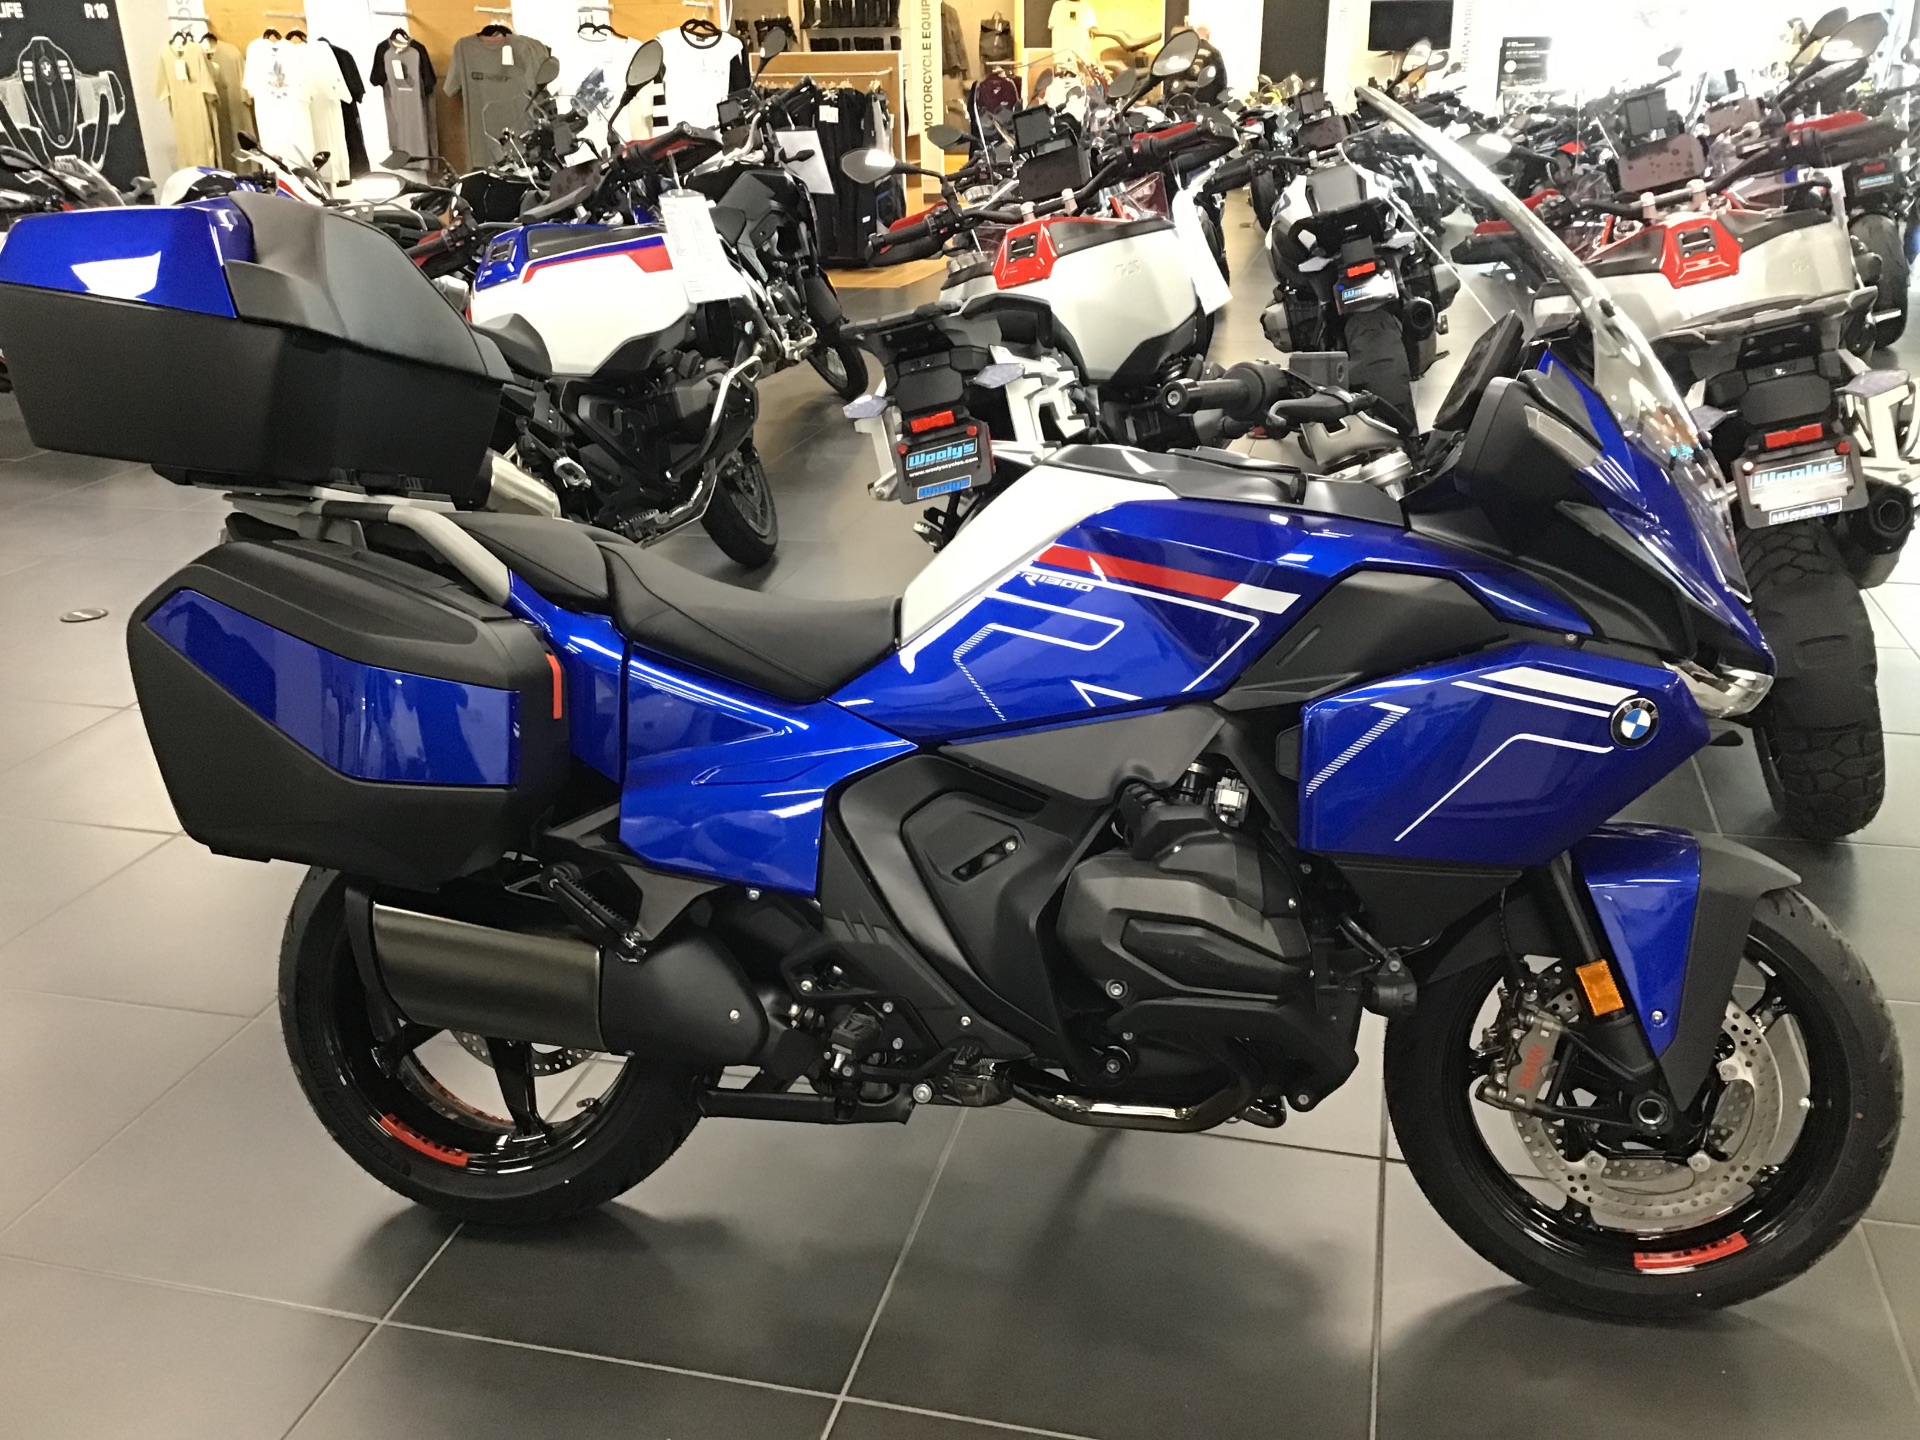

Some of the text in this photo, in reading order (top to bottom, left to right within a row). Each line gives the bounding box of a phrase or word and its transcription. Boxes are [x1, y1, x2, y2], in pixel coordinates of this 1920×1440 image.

[0, 2, 24, 18] IFE
[94, 3, 109, 19] 18
[922, 42, 934, 132] MOTORCYCLE
[909, 442, 975, 468] Wooly's
[1020, 571, 1095, 593] R1300
